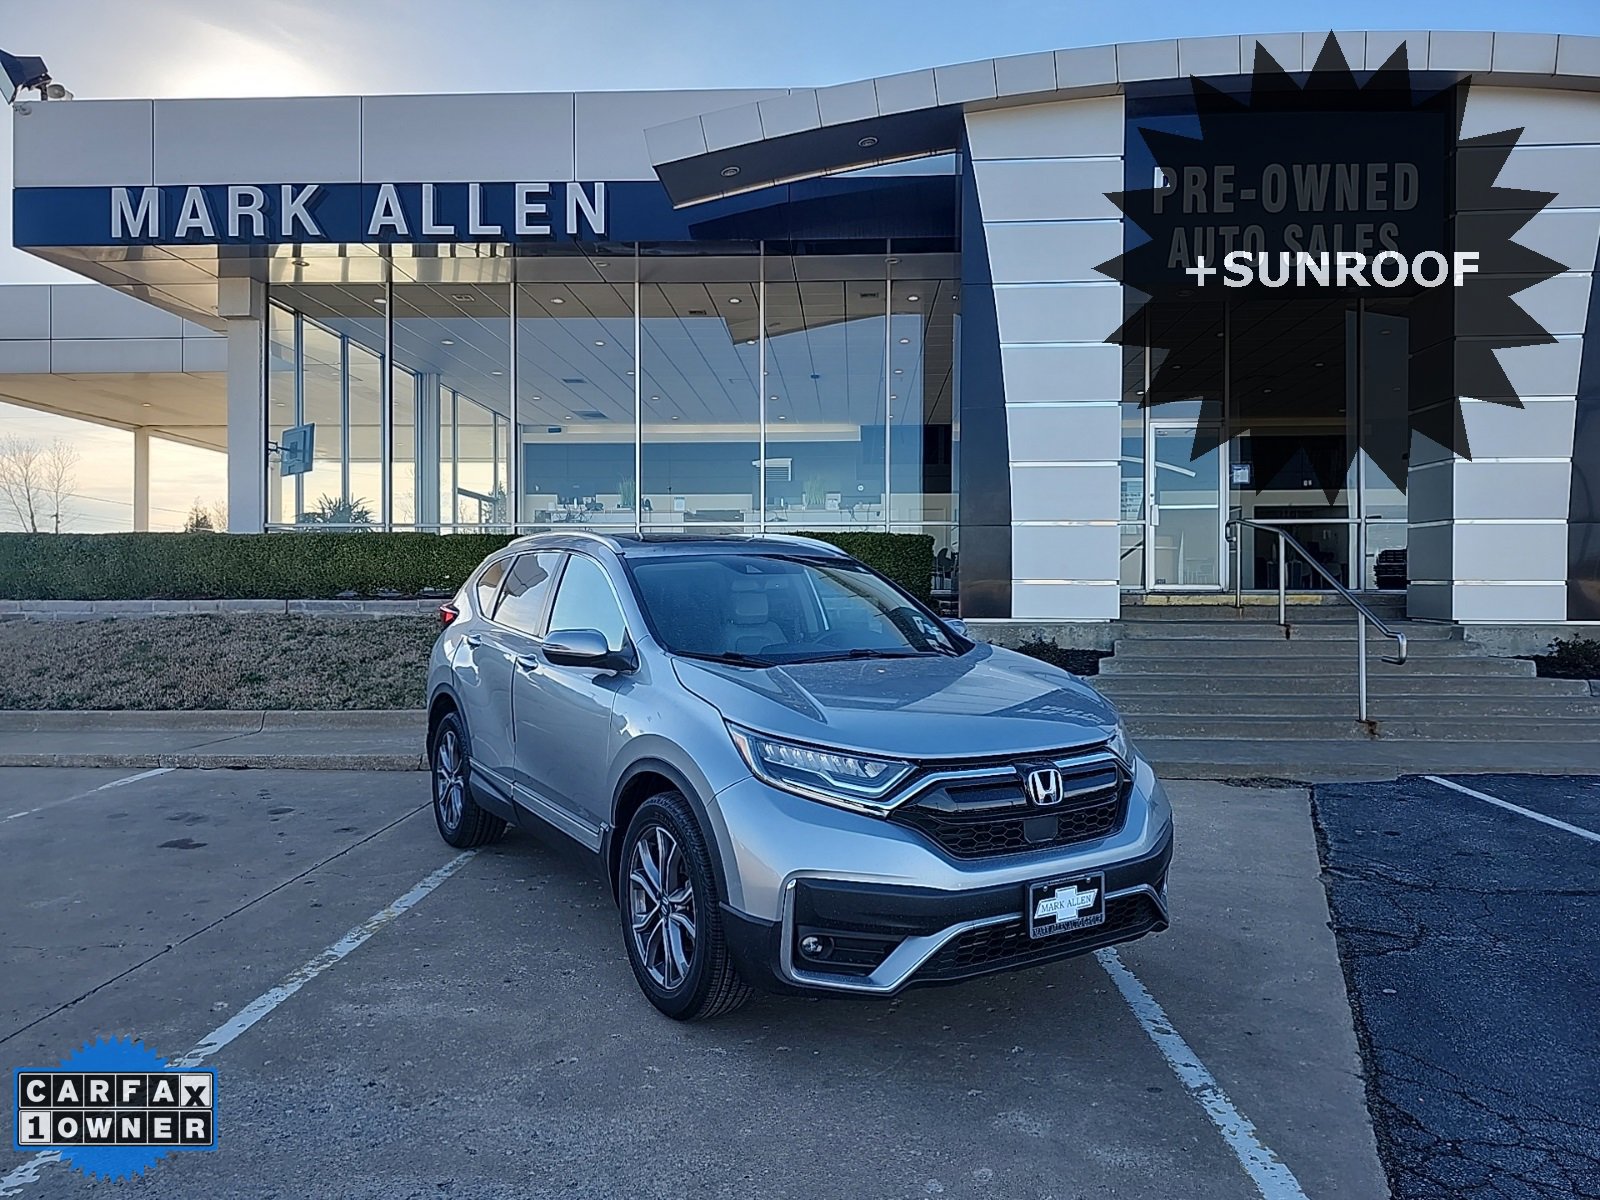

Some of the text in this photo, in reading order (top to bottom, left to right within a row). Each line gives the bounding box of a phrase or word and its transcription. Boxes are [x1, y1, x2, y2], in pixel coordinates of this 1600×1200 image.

[110, 182, 608, 239] MARK ALLEN
[1153, 163, 1420, 214] PRE-OWNED
[1167, 222, 1400, 268] AUTO SALES
[1041, 894, 1092, 913] MARK ALLEN
